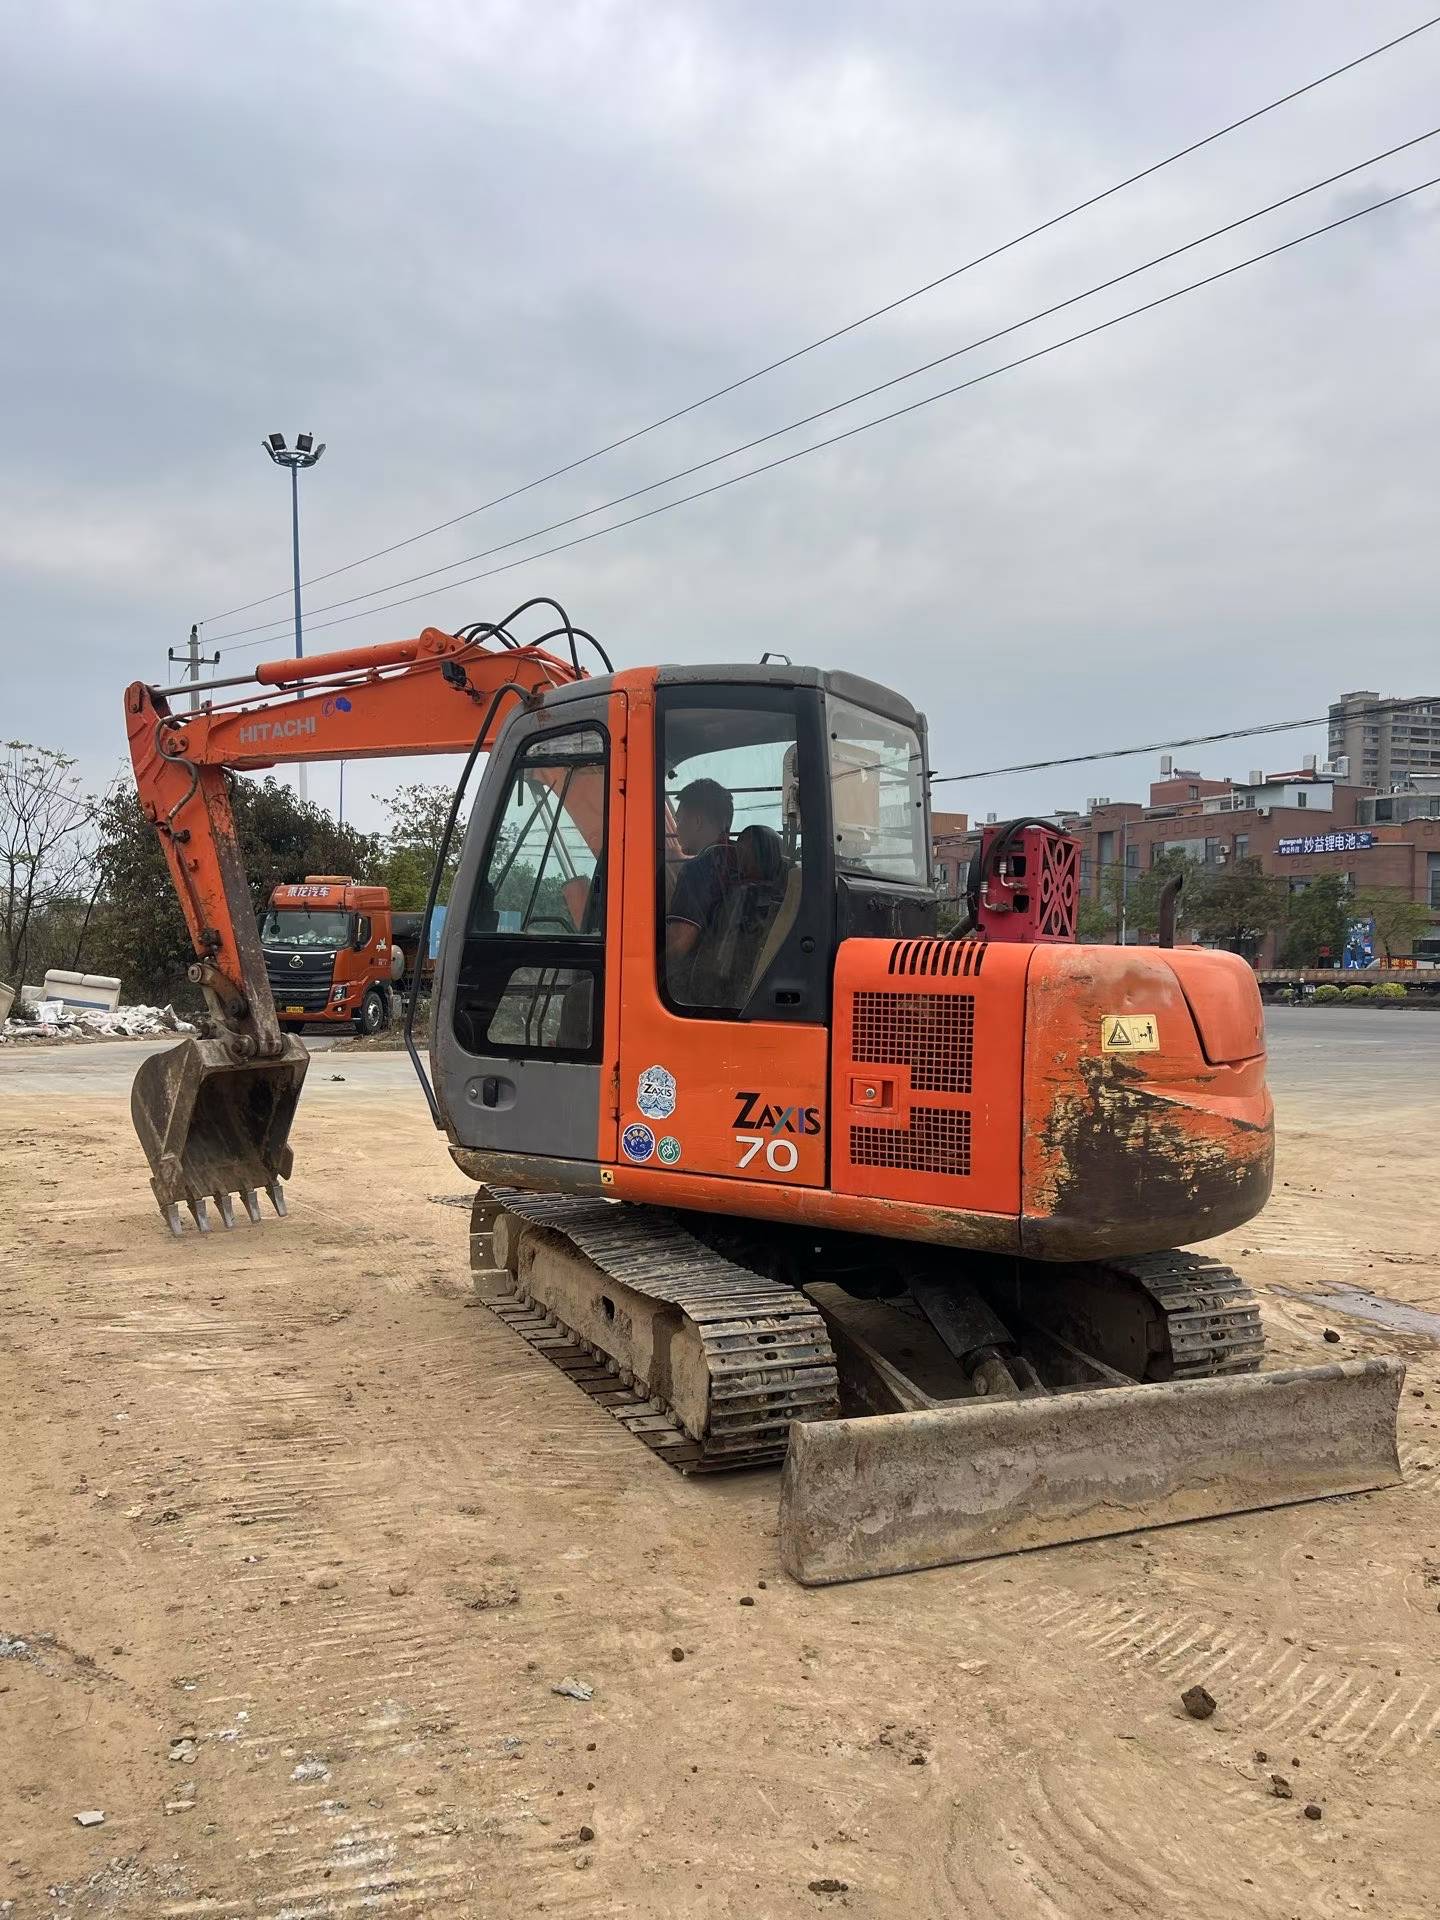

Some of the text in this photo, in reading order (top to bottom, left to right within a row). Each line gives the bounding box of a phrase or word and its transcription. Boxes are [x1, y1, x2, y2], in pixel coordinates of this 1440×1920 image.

[240, 716, 316, 743] HITACHI
[1304, 834, 1356, 853] 妙益锂电池
[643, 1083, 673, 1098] ZAXIS
[732, 1092, 821, 1135] ZAXIS
[735, 1136, 798, 1172] 70
